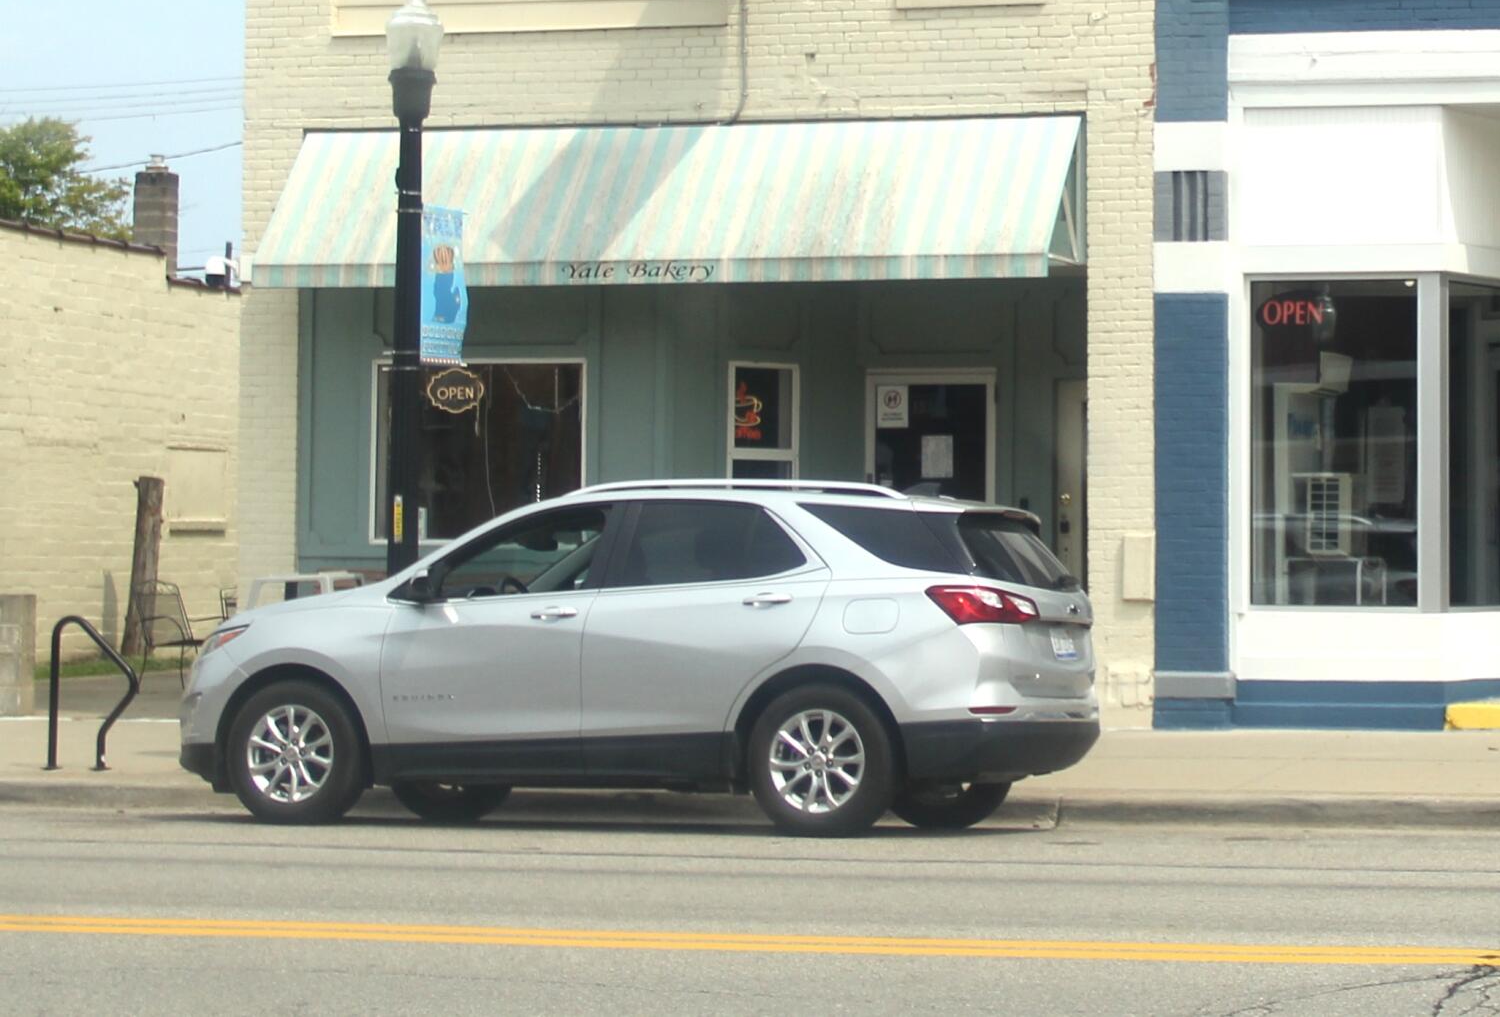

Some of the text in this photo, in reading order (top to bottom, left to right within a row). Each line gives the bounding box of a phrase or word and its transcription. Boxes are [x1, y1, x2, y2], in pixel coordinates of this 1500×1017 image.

[561, 260, 714, 282] Yale Bakery
[1263, 299, 1325, 326] OPEN
[436, 386, 474, 401] OPEN
